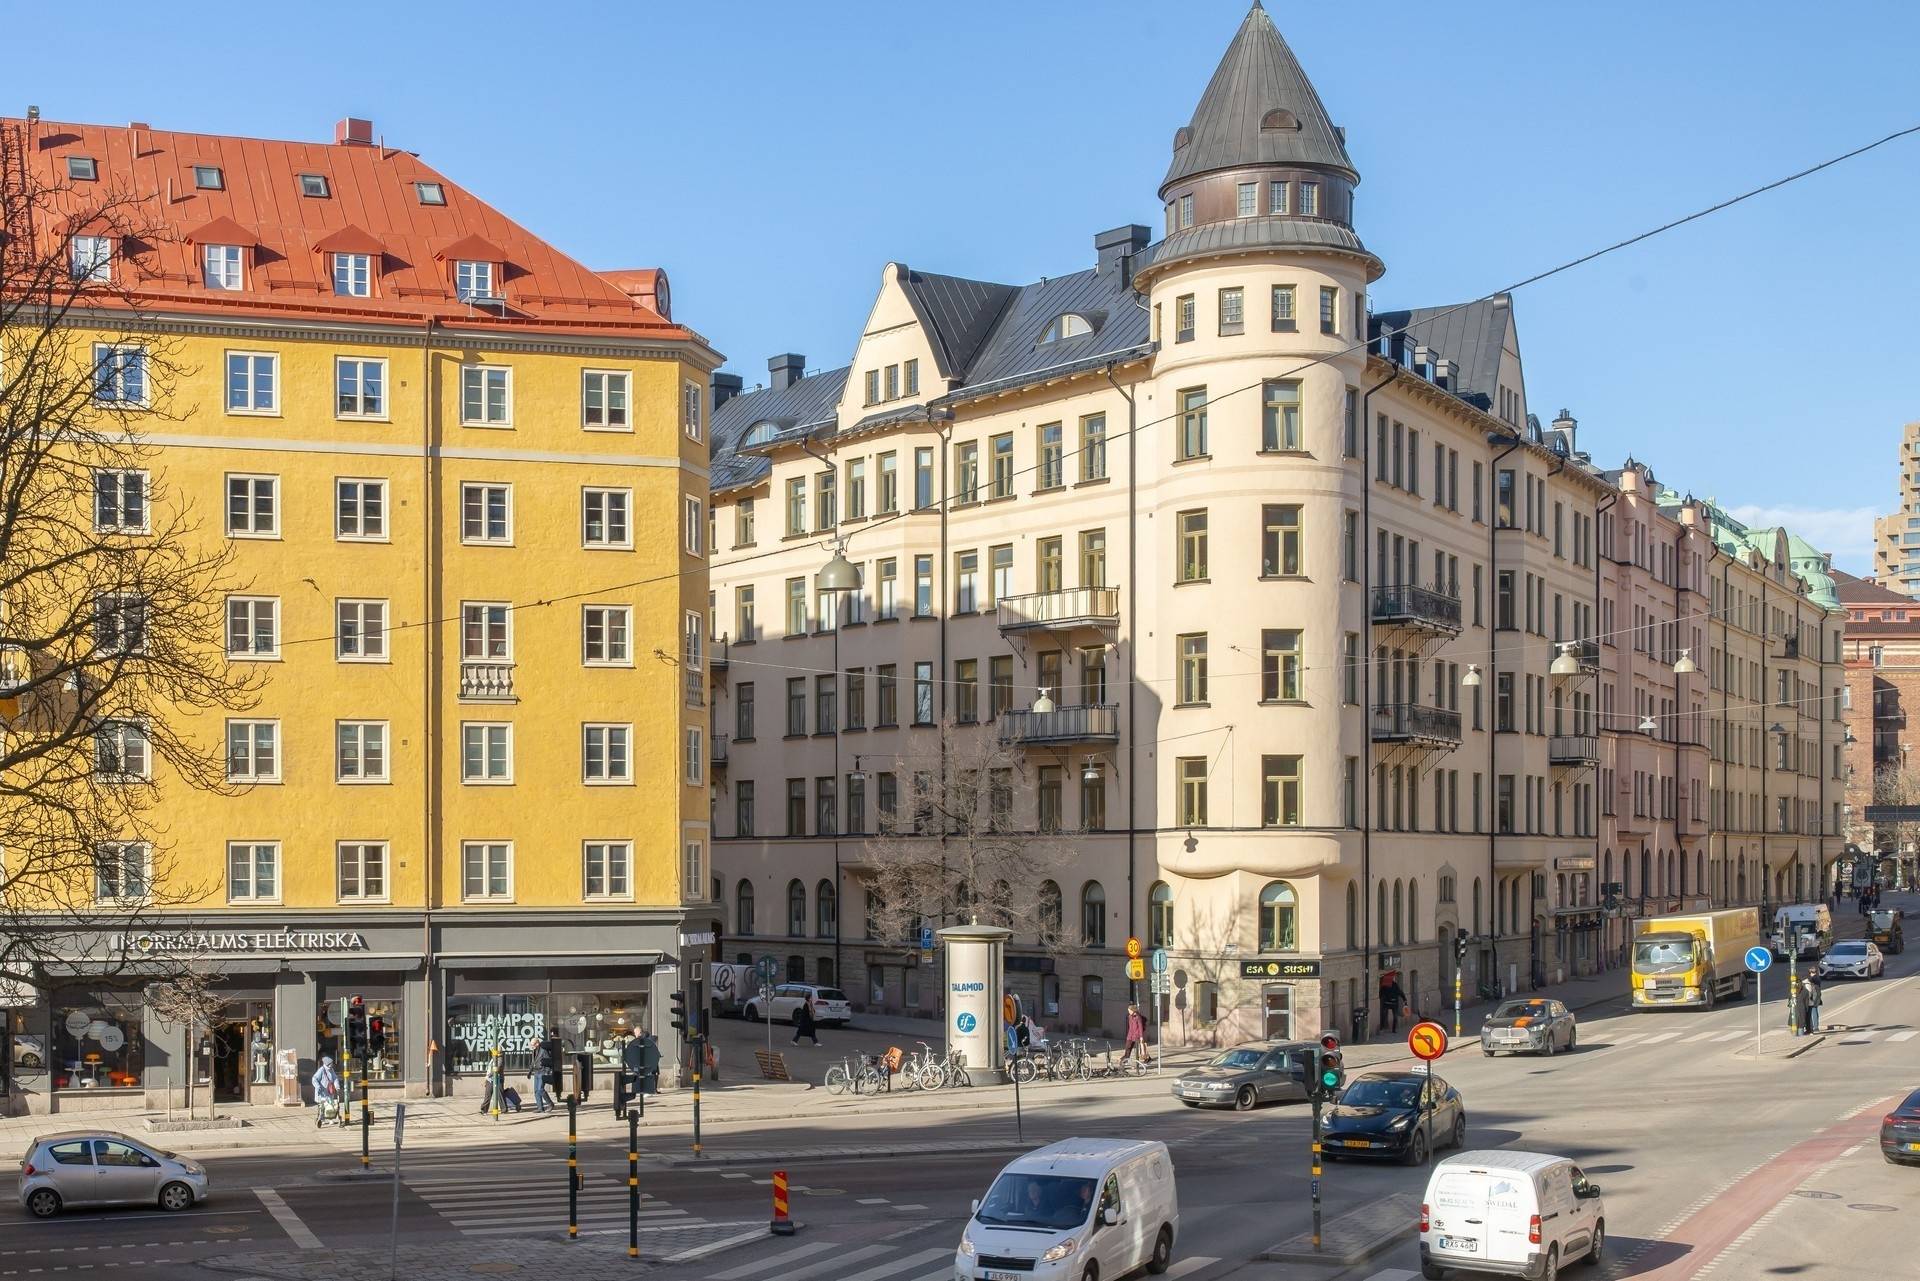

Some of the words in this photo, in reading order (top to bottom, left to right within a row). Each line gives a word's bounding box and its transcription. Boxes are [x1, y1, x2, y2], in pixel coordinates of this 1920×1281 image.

[924, 929, 931, 938] P
[121, 933, 248, 951] NORRMALMS
[256, 932, 363, 948] ELEKTRISKA
[1129, 943, 1138, 952] 30
[465, 1038, 543, 1051] VERKSTA
